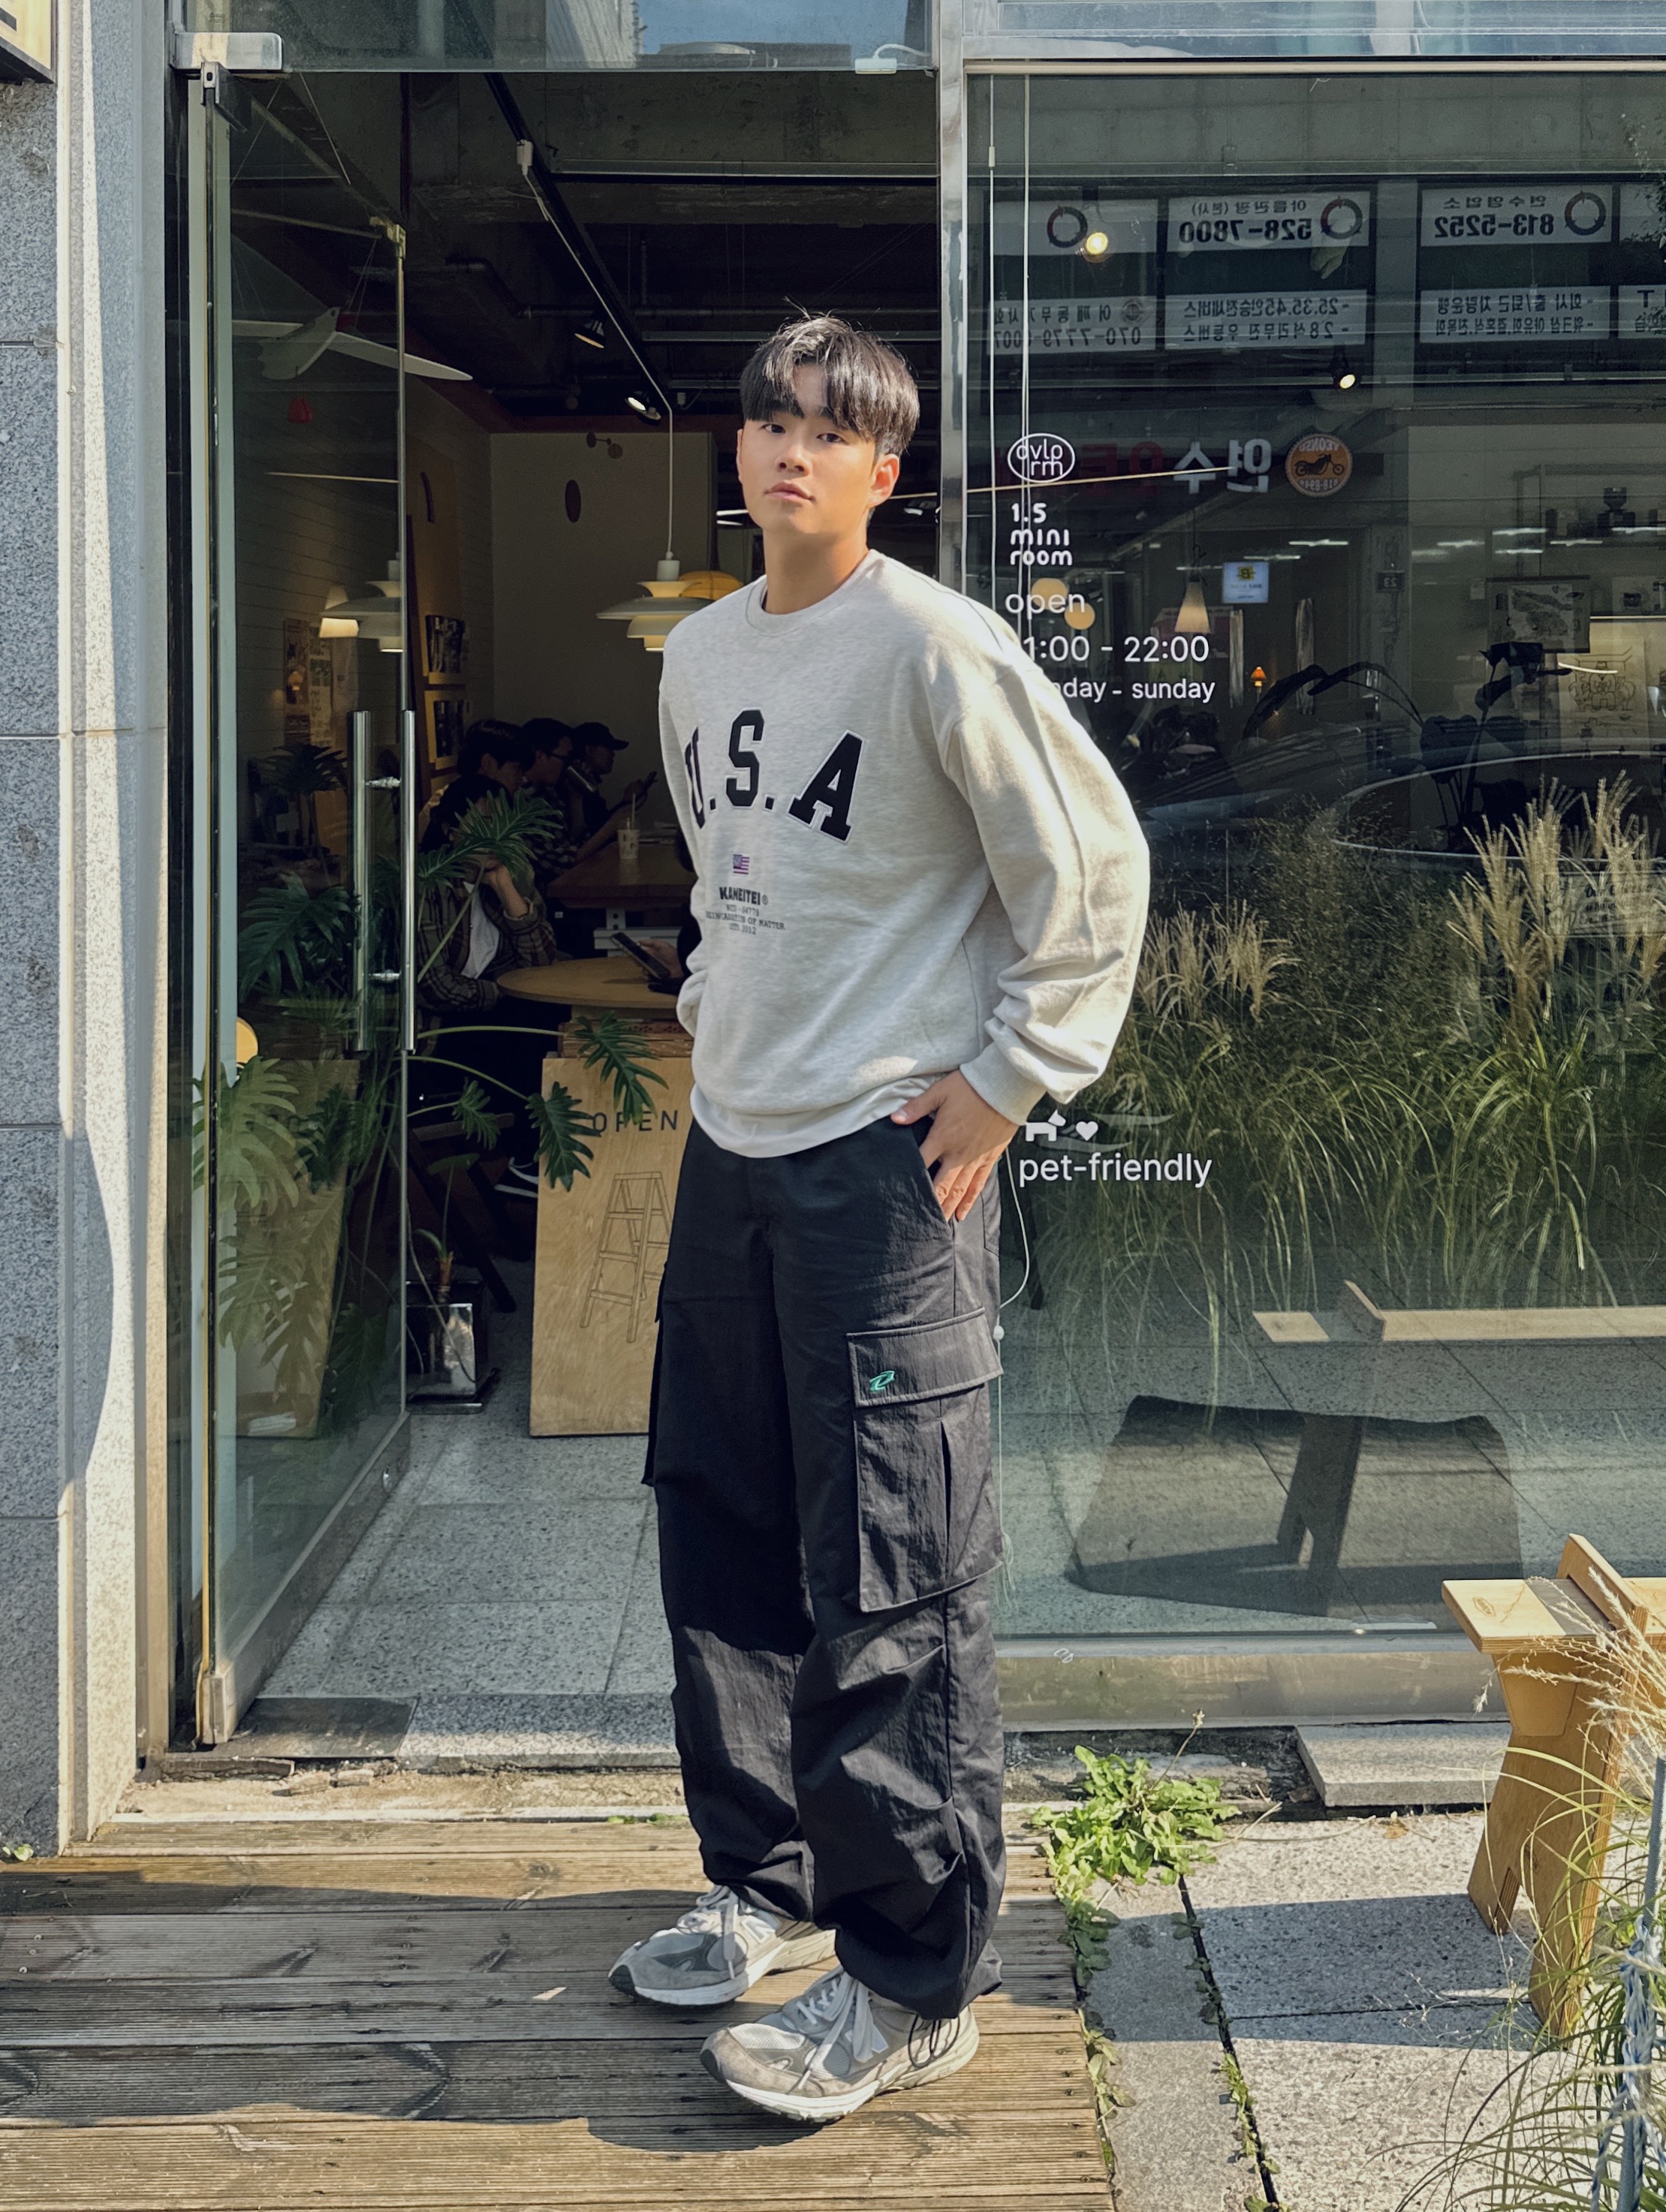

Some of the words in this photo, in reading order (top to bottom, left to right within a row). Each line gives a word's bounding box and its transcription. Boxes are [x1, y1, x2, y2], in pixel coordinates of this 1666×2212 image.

[1011, 503, 1047, 523] 1.5
[1010, 528, 1070, 546] mini
[1010, 550, 1073, 566] room
[1005, 594, 1086, 620] open
[1125, 635, 1209, 662] 22:00
[1131, 678, 1216, 703] sunday
[748, 917, 758, 925] OF
[759, 919, 785, 931] MATTER
[593, 1110, 678, 1133] OPEN
[1020, 1152, 1212, 1188] pet-friendly
